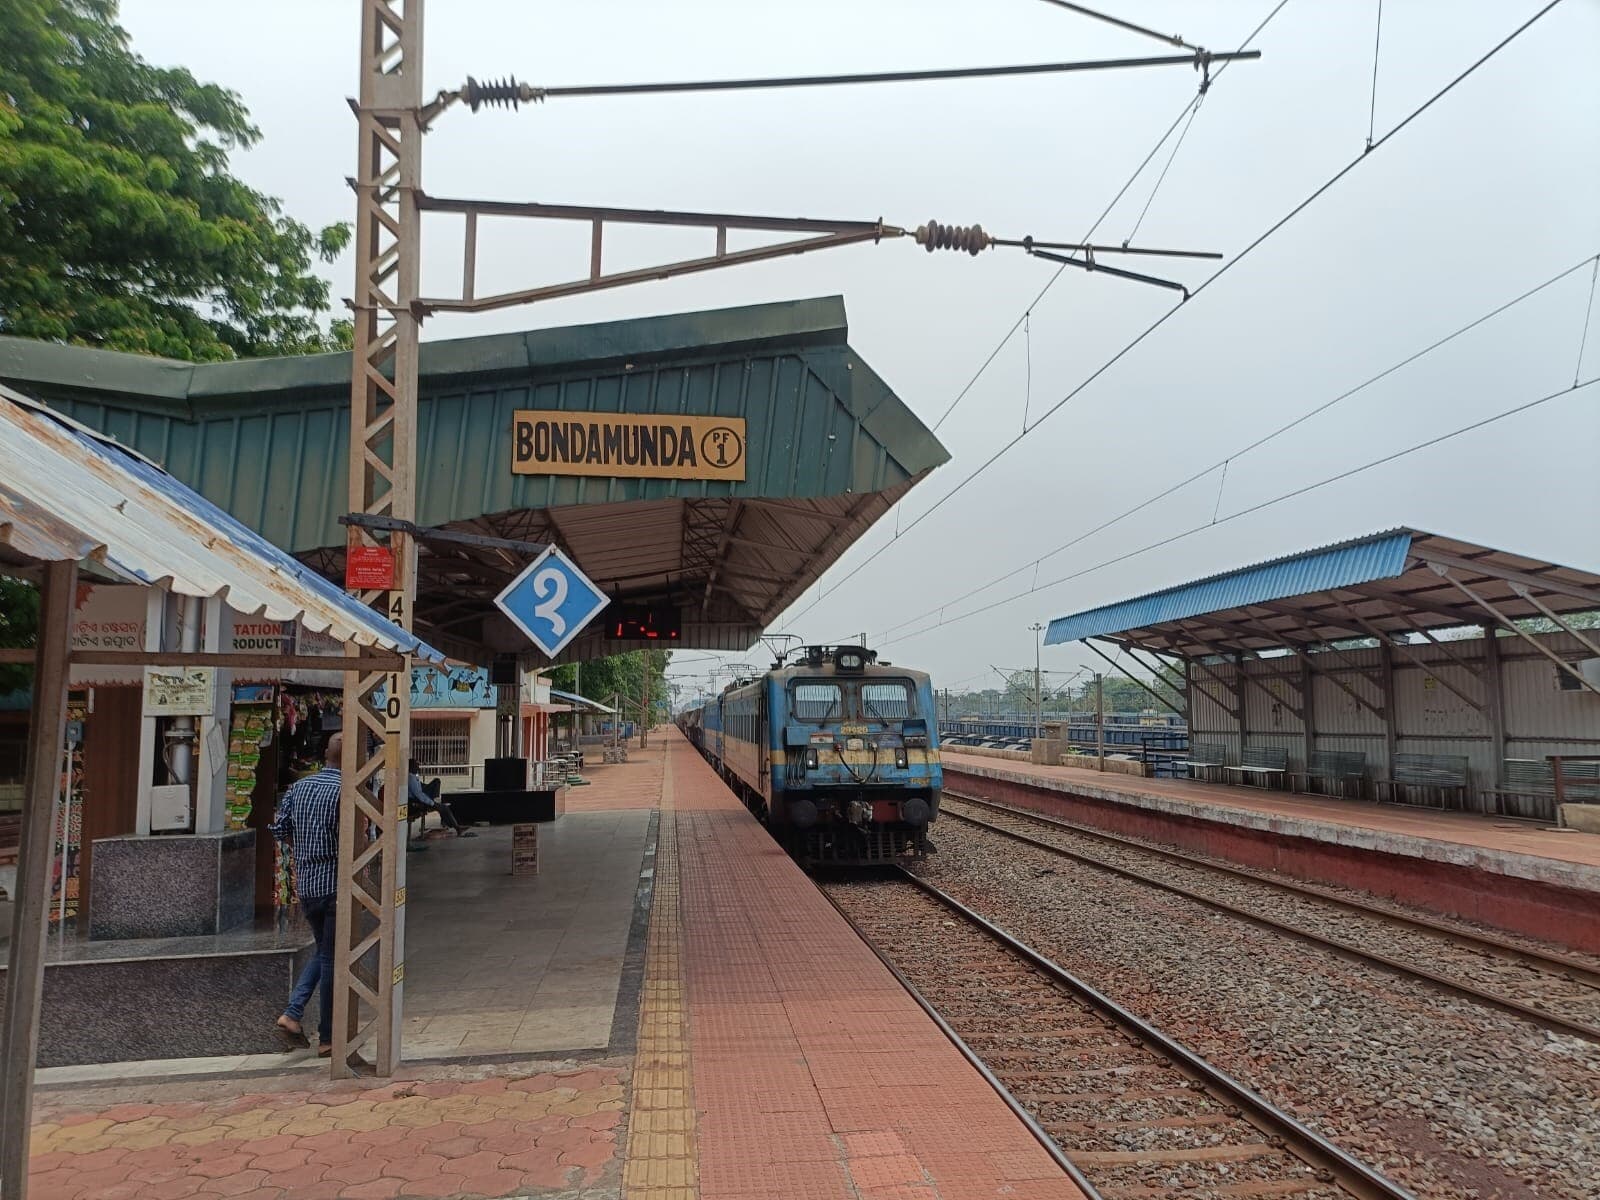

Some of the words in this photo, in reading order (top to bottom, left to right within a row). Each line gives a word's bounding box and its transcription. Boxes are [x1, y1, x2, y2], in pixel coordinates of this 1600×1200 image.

[516, 421, 698, 467] BONDAMUNDA
[712, 432, 730, 444] PF
[716, 443, 728, 465] 1
[234, 624, 281, 636] TATION
[233, 638, 281, 650] RODUCT
[387, 673, 401, 719] 10
